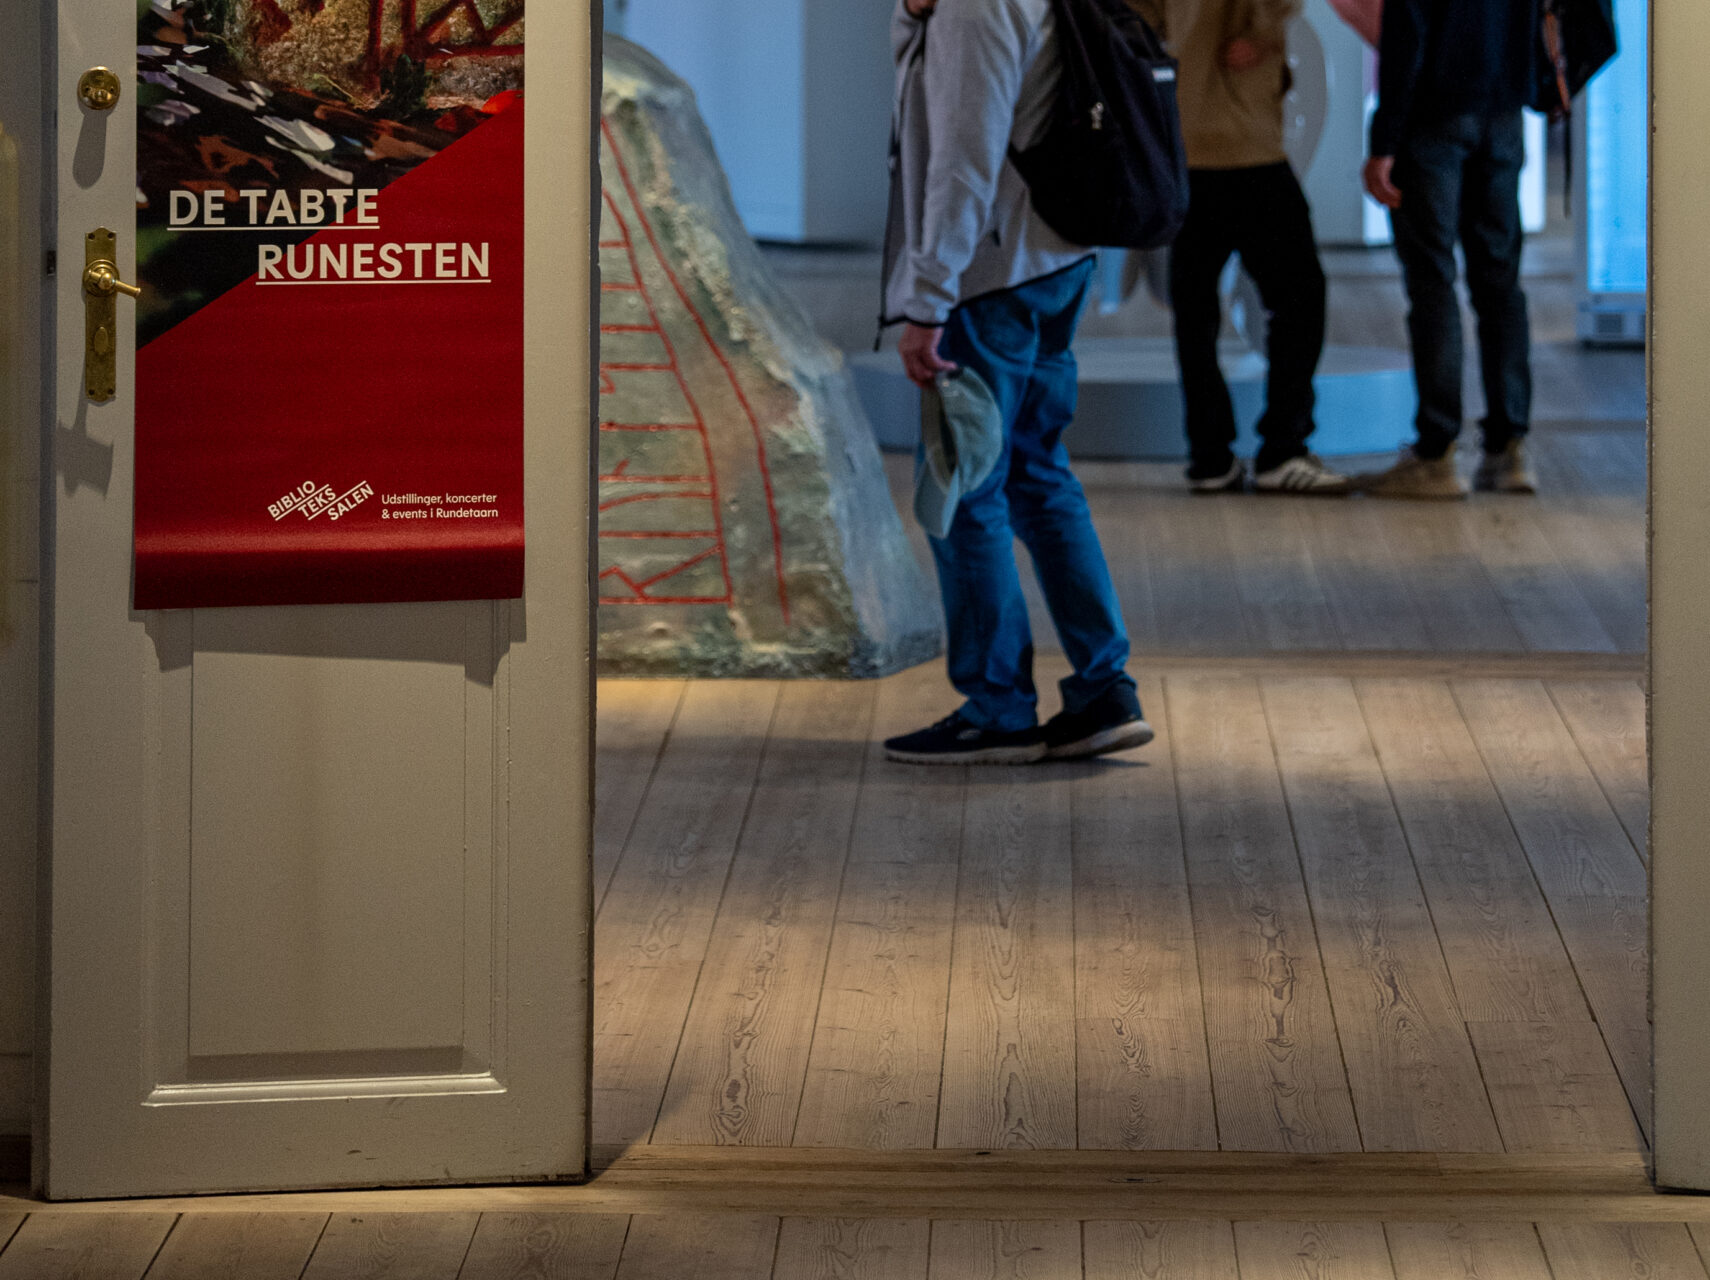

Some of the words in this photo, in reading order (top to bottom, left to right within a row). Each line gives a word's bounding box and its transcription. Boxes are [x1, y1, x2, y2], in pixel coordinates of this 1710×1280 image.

[169, 190, 225, 225] DE
[240, 189, 378, 224] TABTE
[258, 242, 489, 279] RUNESTEN
[267, 480, 316, 518] BIBLIO
[298, 487, 336, 517] TEKS
[327, 484, 375, 521] SALEN
[381, 493, 443, 505] Udstillinger,
[446, 493, 497, 504] koncerter
[381, 509, 390, 519] &
[393, 508, 427, 519] events
[430, 508, 434, 518] i
[436, 508, 498, 518] Rundetaarn
